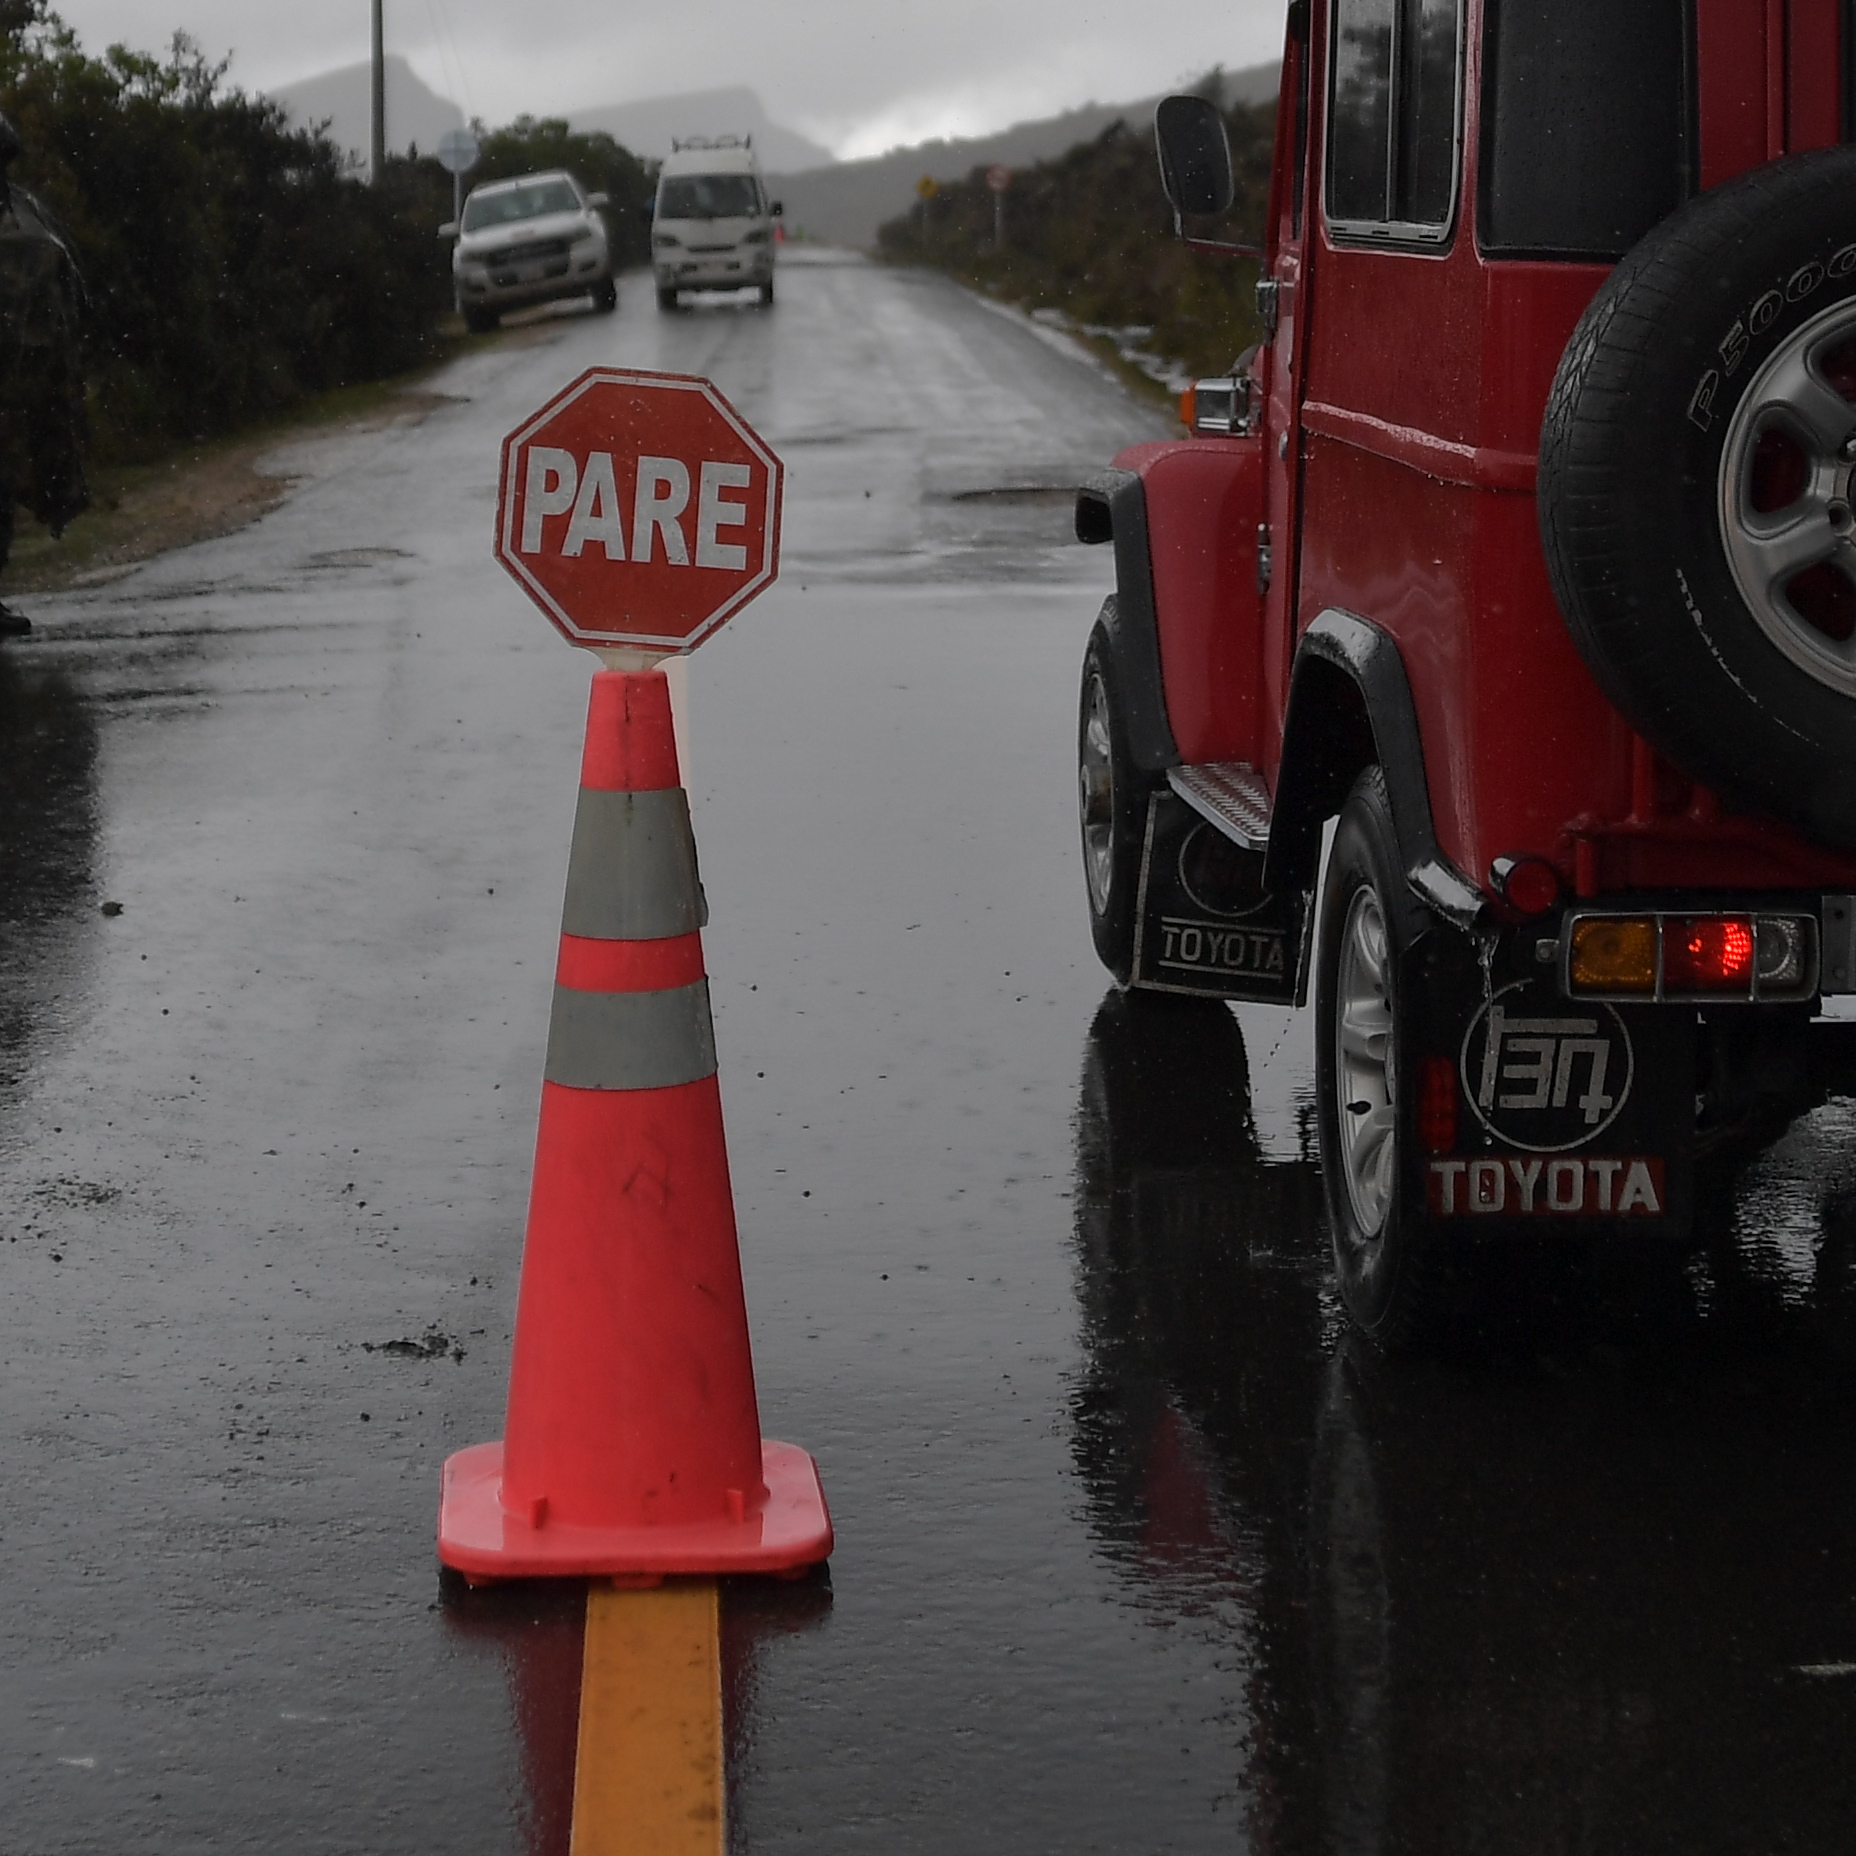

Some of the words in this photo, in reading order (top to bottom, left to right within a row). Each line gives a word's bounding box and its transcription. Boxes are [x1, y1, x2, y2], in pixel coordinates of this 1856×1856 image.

[521, 445, 751, 571] PARE
[1161, 925, 1285, 972] TOYOTA
[1430, 1159, 1661, 1214] TOYOTA
